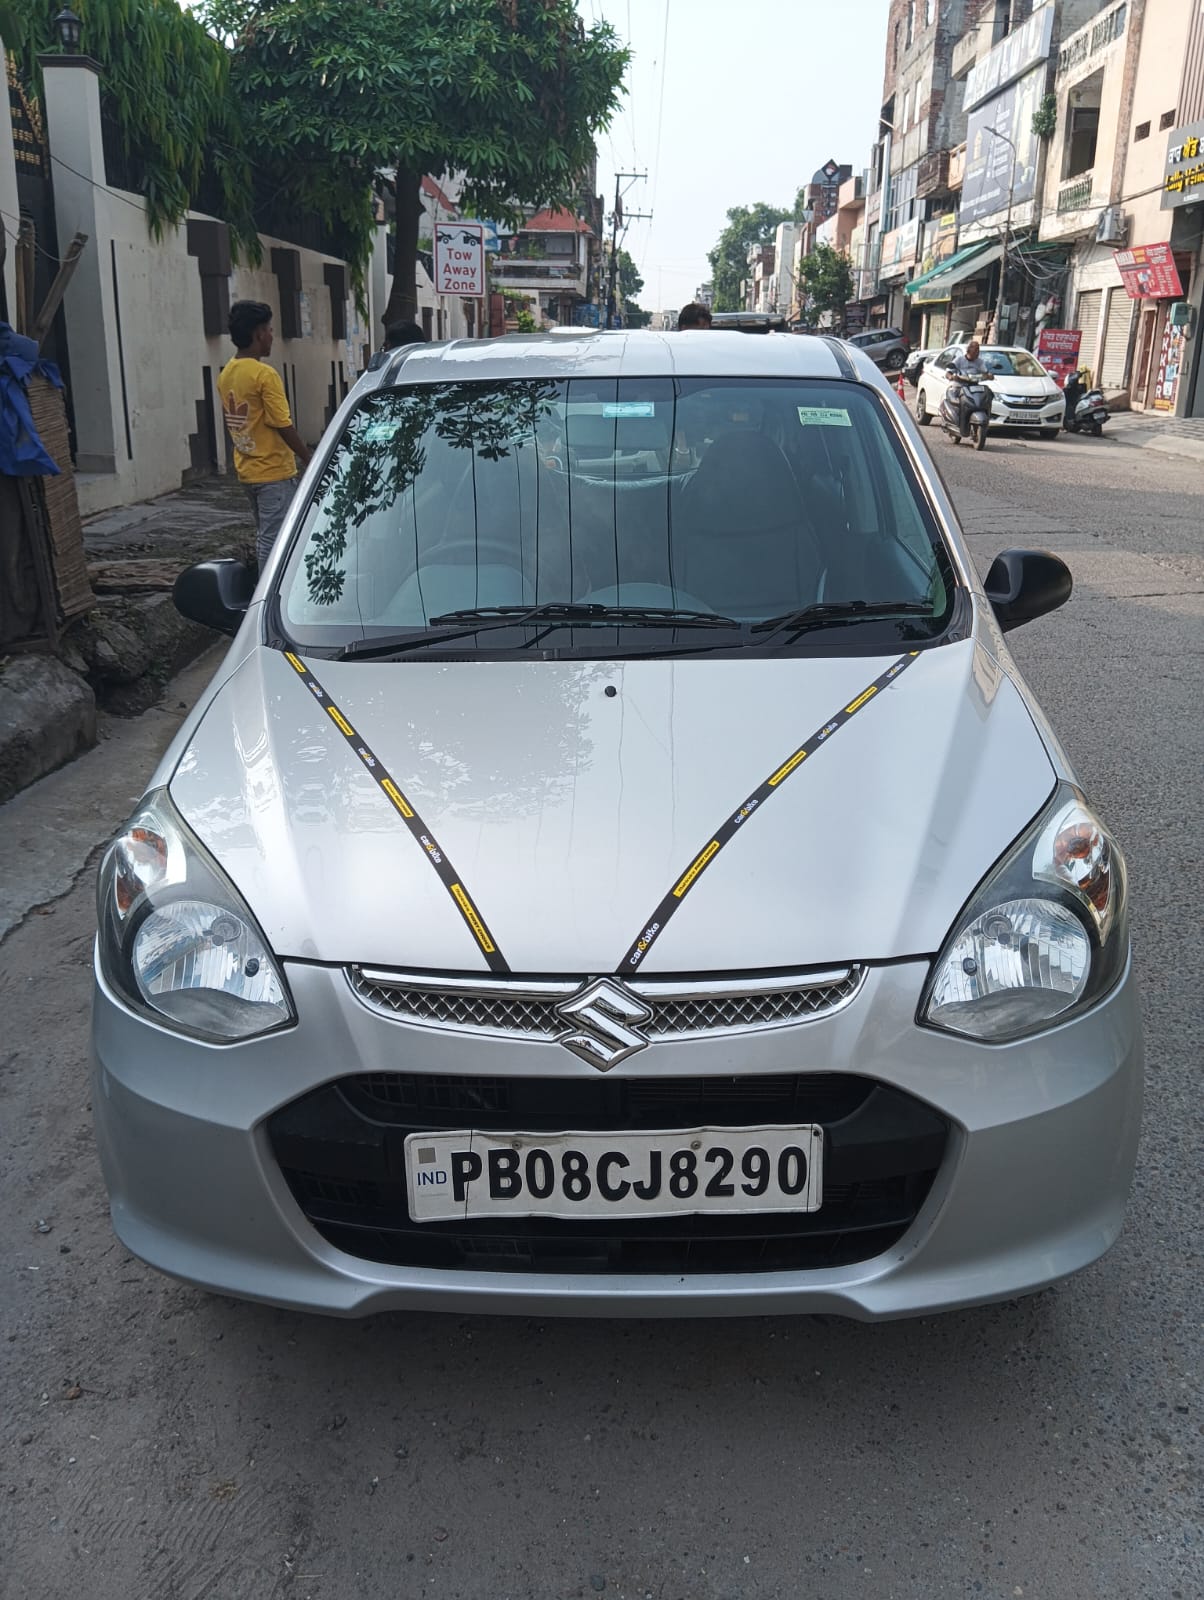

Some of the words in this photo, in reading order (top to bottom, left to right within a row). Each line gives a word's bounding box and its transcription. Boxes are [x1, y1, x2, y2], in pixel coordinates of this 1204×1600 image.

[446, 247, 473, 261] Tow
[443, 263, 477, 278] Away
[444, 278, 476, 291] Zone
[734, 799, 759, 824] car&bike
[420, 835, 441, 864] car&bike
[629, 922, 660, 965] car&bike
[417, 1170, 448, 1186] IND
[450, 1146, 808, 1201] PB08CJ8290
